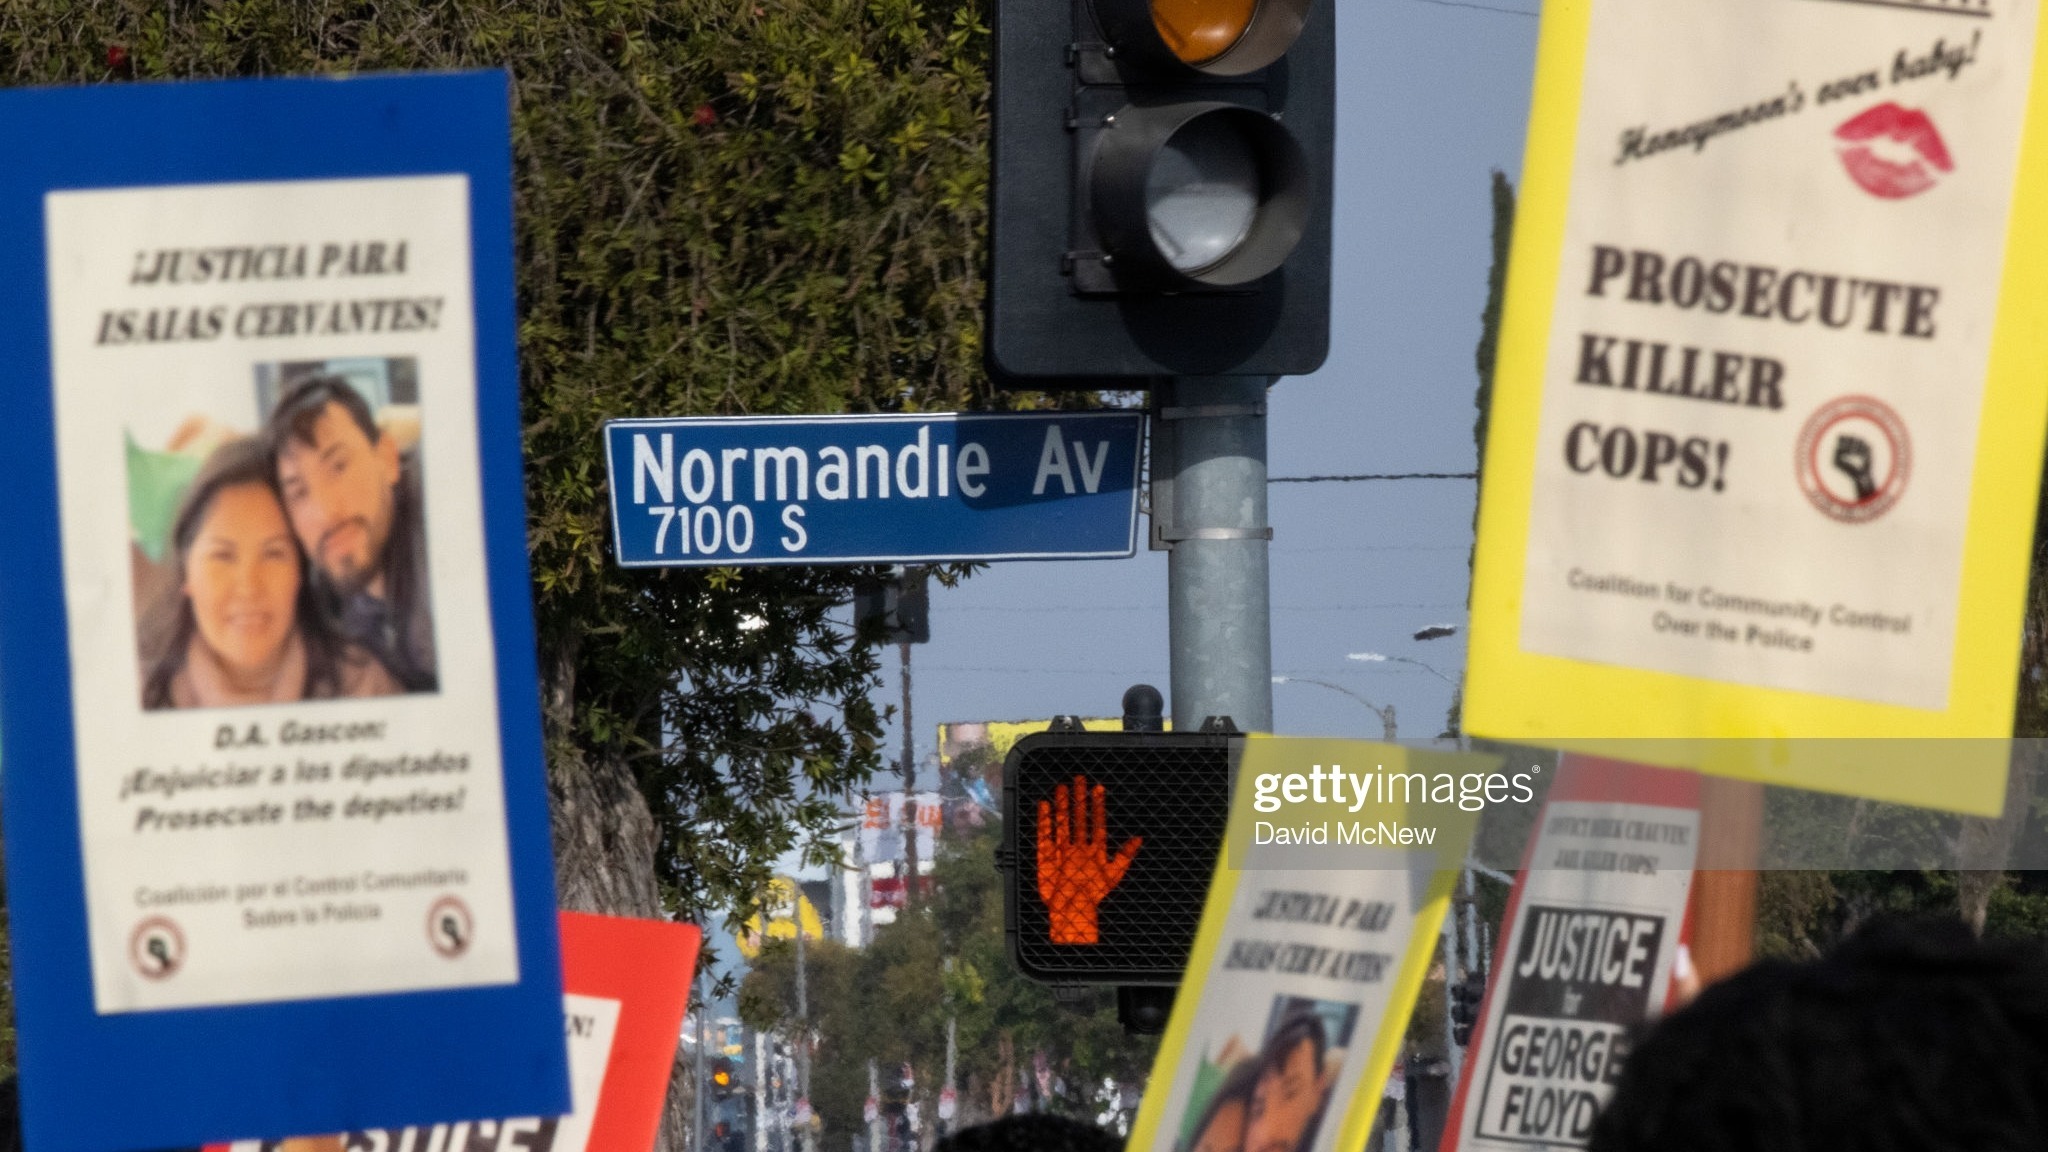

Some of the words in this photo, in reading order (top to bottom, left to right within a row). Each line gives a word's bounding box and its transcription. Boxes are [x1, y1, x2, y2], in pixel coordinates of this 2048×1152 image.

[1614, 80, 1804, 166] Honeymoon's
[1817, 69, 1881, 106] over
[1890, 28, 1981, 84] baby!
[317, 240, 408, 278] PARA
[1585, 244, 1940, 339] PROSECUTE
[95, 305, 228, 346] ISAIAS
[234, 296, 445, 339] CERVANTES!
[1574, 333, 1787, 411] KILLER
[632, 425, 991, 504] Normandie
[1032, 425, 1109, 495] Av
[1563, 420, 1731, 493] COPS!
[648, 505, 754, 555] 7100
[780, 505, 808, 552] S
[1567, 567, 1661, 600] Coalition
[1665, 581, 1694, 603] for
[1698, 586, 1823, 627] Community
[1829, 603, 1913, 633] Control
[1652, 610, 1700, 637] Over
[1705, 621, 1739, 643] the
[1745, 625, 1815, 653] Police
[214, 724, 269, 750] D.A.
[279, 719, 388, 746] Gascon:
[119, 762, 263, 800] ¡Enjuiciar
[269, 763, 287, 786] a
[295, 758, 333, 783] los
[340, 749, 471, 783] diputados
[134, 802, 284, 833] Prosecute
[293, 797, 334, 822] the
[343, 785, 467, 823] deputies!
[293, 874, 358, 897] Control
[360, 867, 470, 892] Comunitario
[1519, 912, 1655, 988] JUSTICE
[1500, 1023, 1629, 1085] GEORGE
[1500, 1086, 1602, 1139] FLOYD
